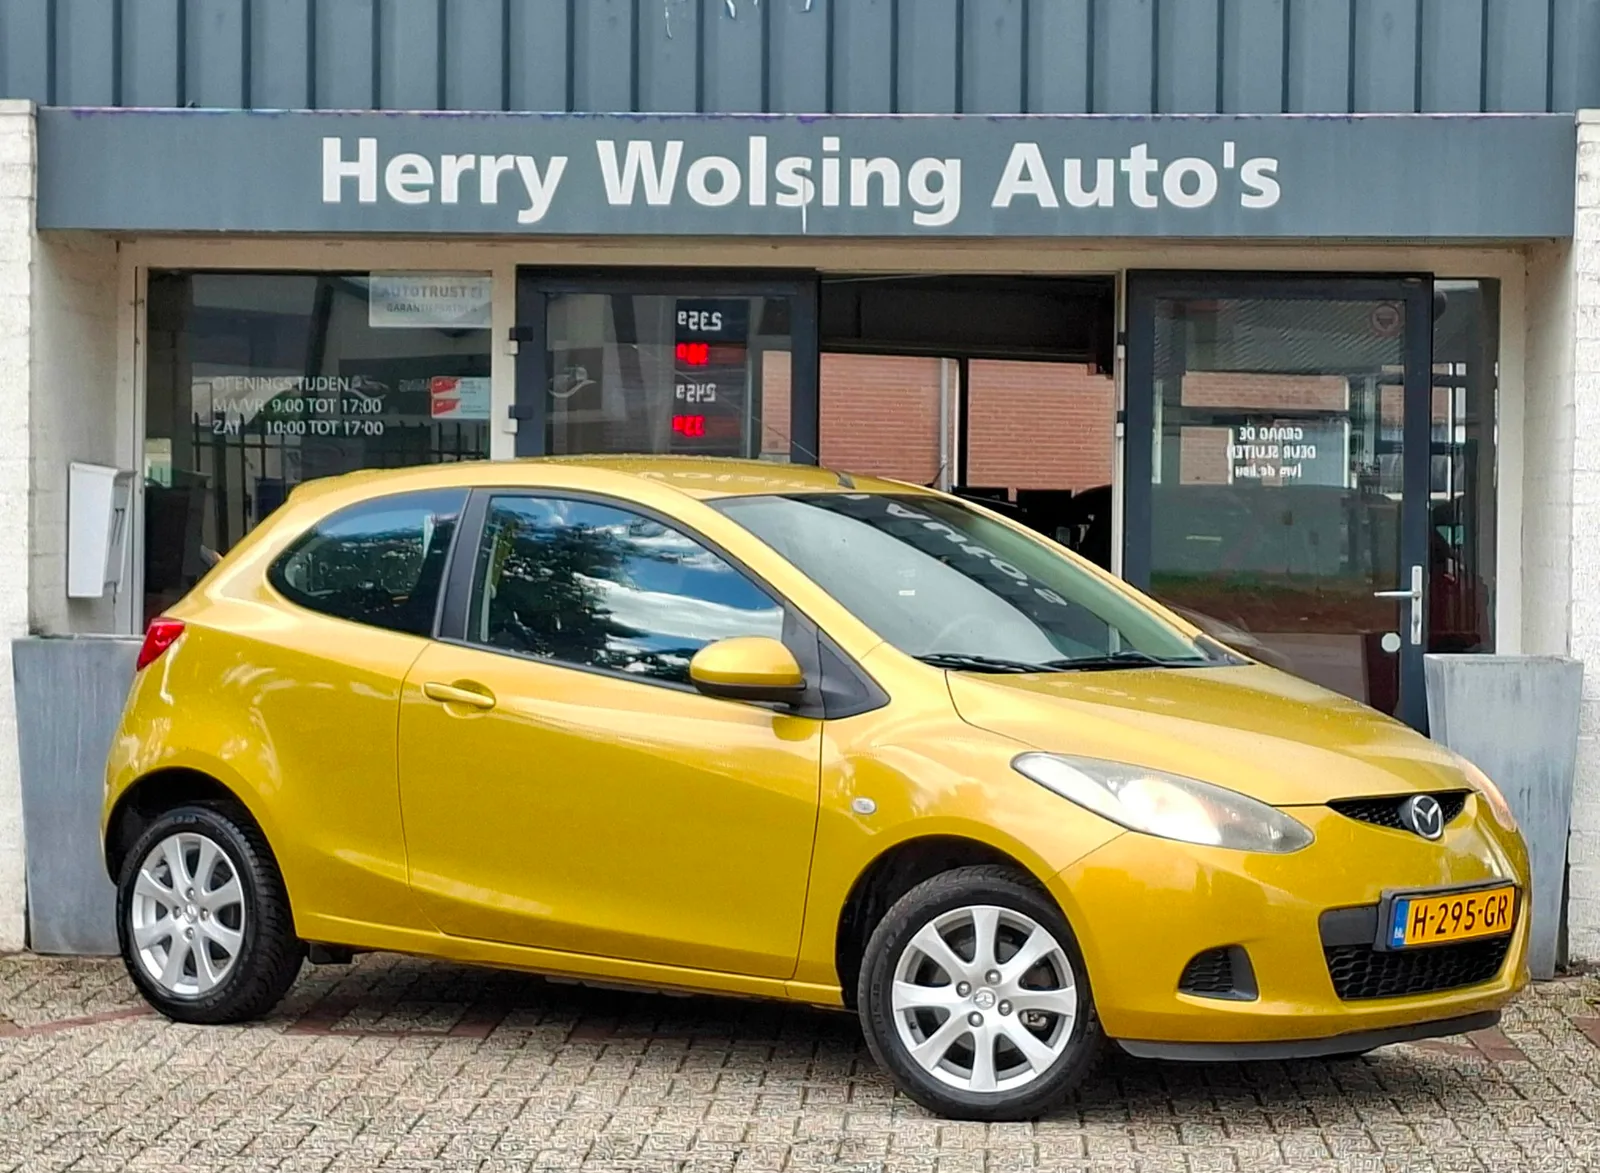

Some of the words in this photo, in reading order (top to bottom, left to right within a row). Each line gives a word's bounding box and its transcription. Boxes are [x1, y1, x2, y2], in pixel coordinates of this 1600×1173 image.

[321, 136, 568, 224] Herry
[594, 135, 962, 227] Wolsing
[991, 141, 1281, 209] Auto's
[308, 399, 337, 414] TOT
[266, 421, 306, 435] 10:00
[309, 421, 338, 435] TOT
[1411, 894, 1508, 939] H-295-GR
